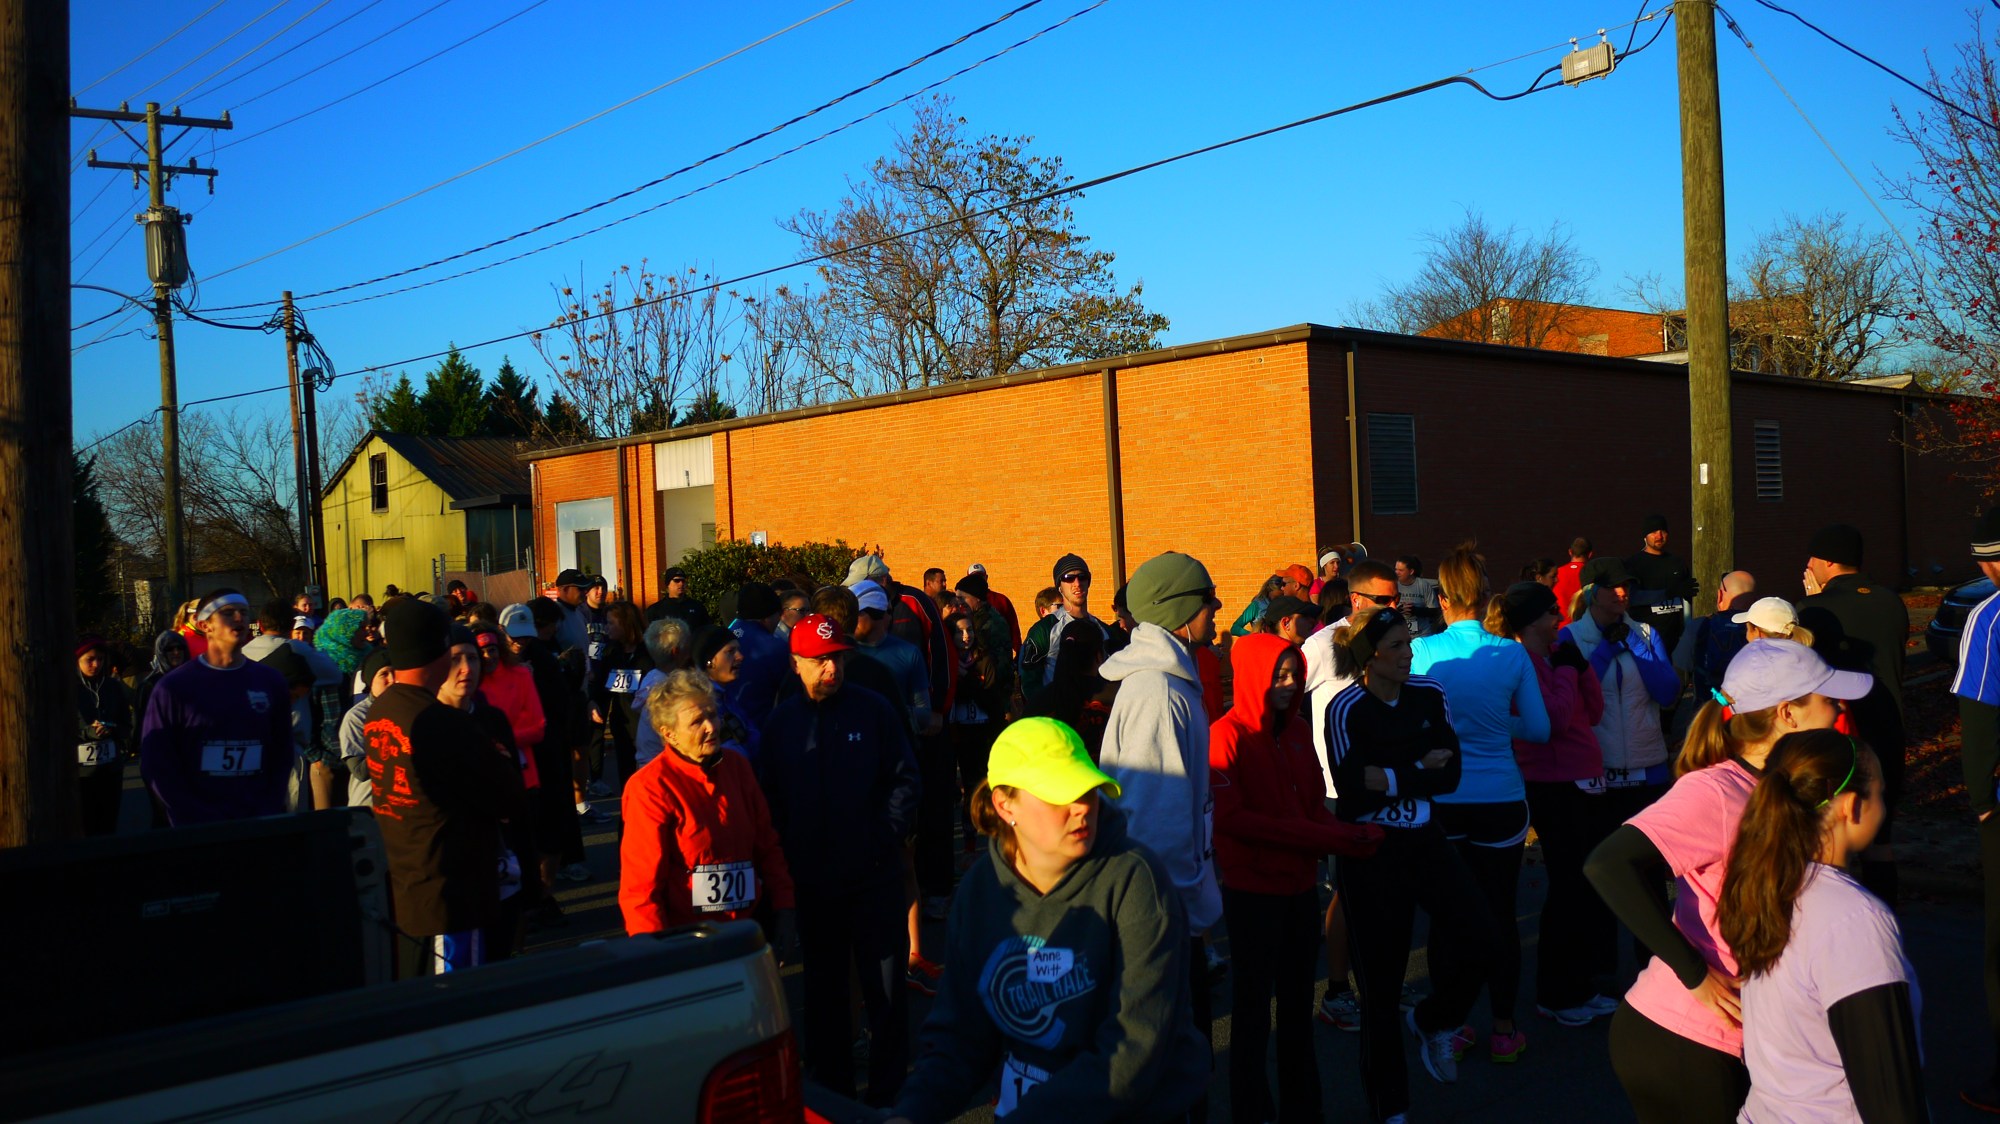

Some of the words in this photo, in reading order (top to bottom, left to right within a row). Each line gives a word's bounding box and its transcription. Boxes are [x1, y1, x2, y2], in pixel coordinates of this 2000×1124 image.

[613, 674, 633, 689] 319
[86, 744, 110, 762] 224
[222, 747, 247, 771] 57
[707, 871, 745, 904] 320
[1033, 951, 1062, 962] Anne
[1007, 981, 1053, 1015] TRAIL
